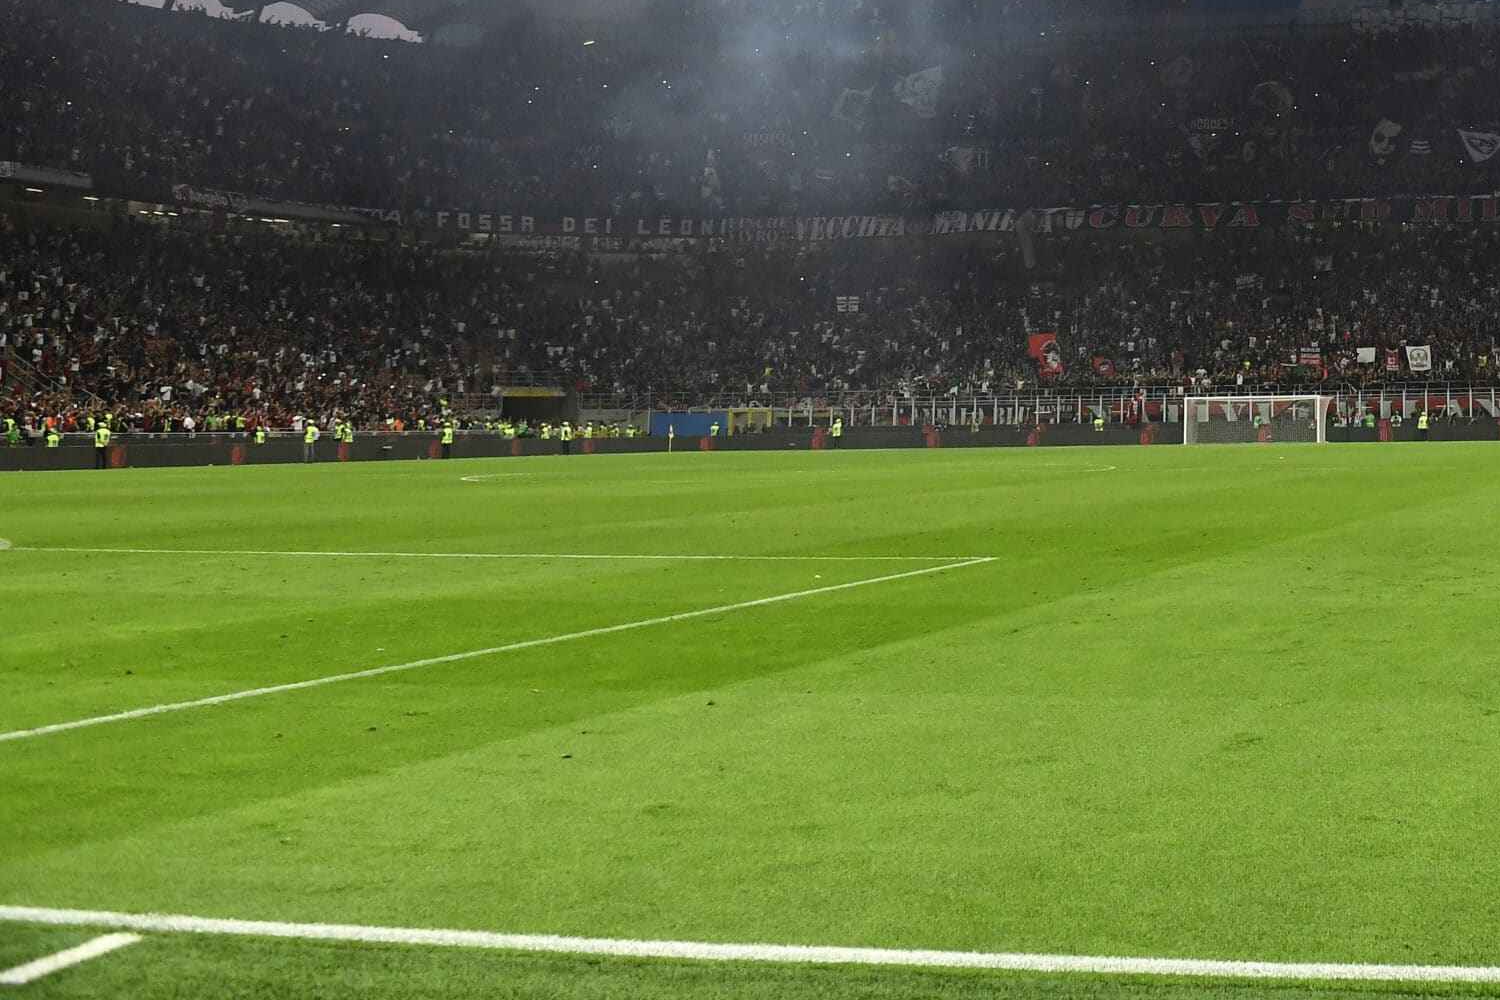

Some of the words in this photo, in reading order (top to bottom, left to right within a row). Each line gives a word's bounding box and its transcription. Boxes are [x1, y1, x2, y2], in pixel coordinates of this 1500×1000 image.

[436, 210, 536, 233] FOSSA
[562, 216, 613, 235] DEI
[638, 217, 727, 236] LEONI
[796, 214, 905, 241] VECCHIA
[927, 207, 1053, 235] MANIEA
[1088, 204, 1261, 228] CURVA
